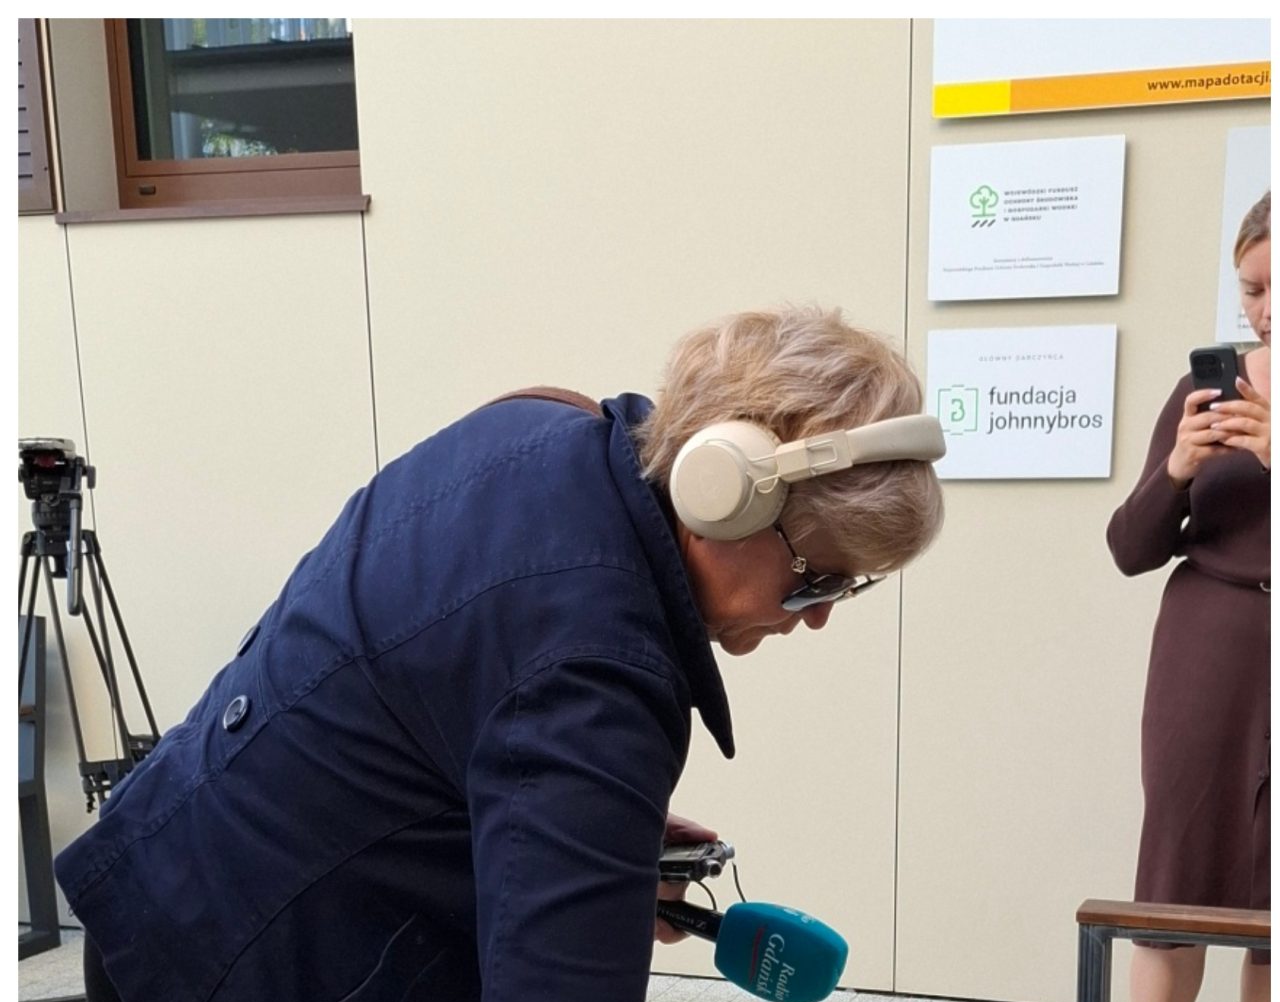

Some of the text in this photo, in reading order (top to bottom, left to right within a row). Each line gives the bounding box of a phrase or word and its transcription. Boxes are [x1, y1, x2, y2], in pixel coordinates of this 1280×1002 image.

[988, 385, 1077, 409] fundacja
[986, 410, 1103, 435] johnnybros
[776, 962, 796, 1000] Radio
